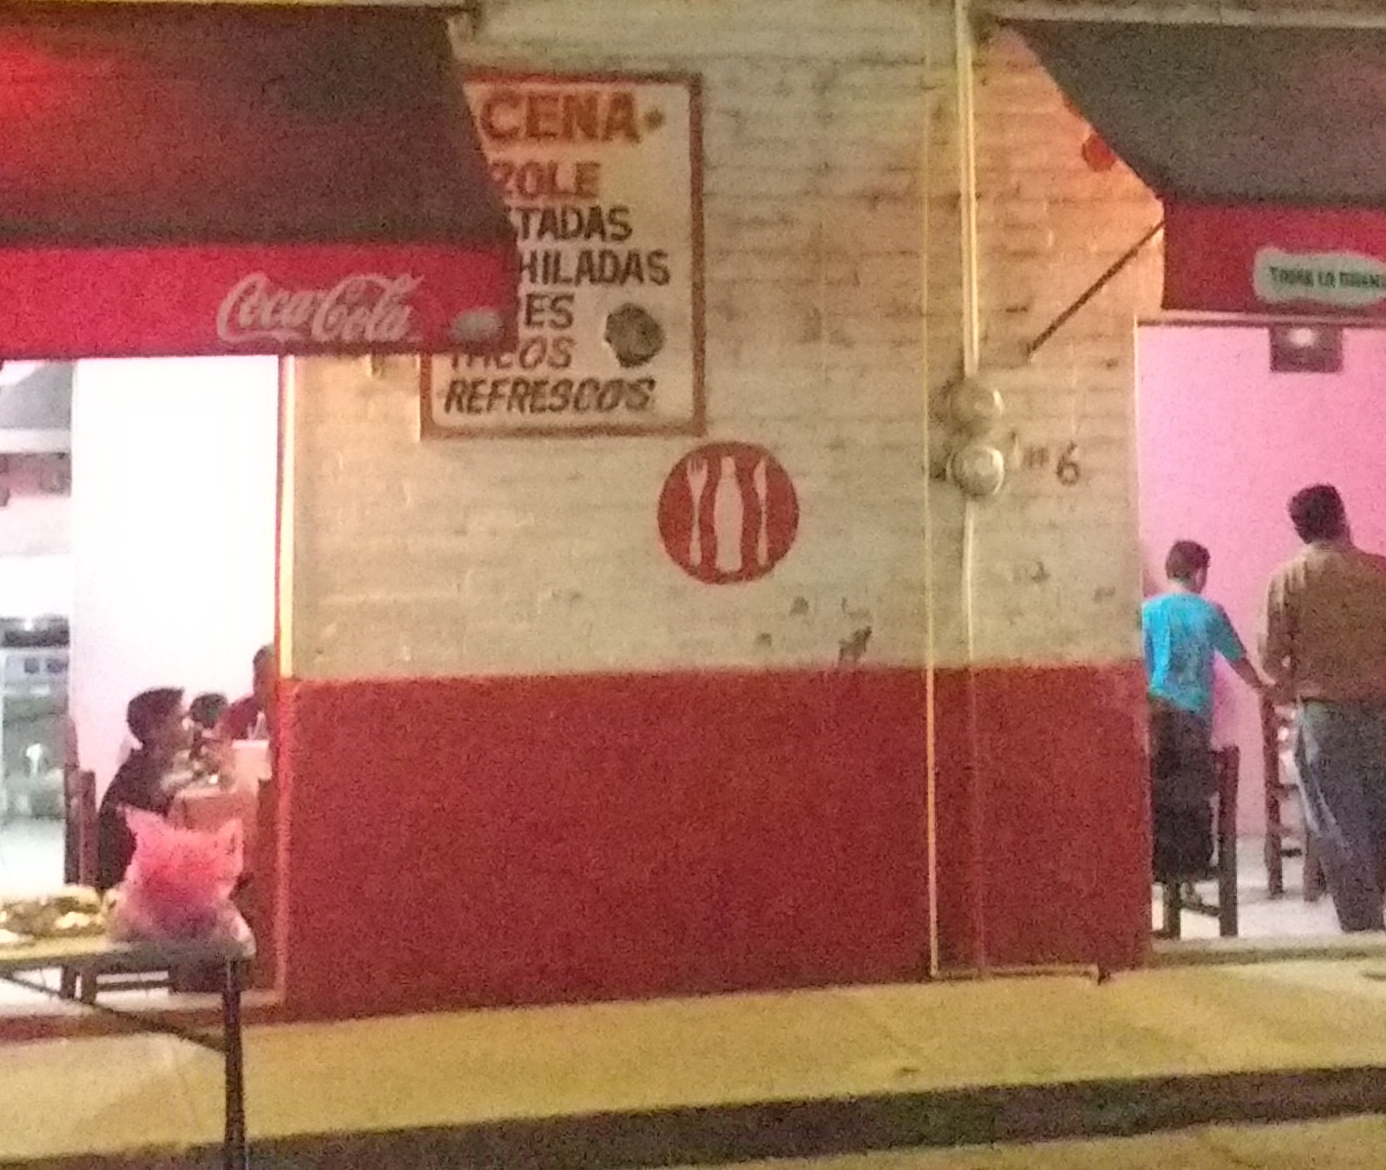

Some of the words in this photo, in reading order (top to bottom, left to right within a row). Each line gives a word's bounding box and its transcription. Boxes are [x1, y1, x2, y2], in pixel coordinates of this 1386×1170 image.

[479, 90, 641, 145] CENA
[508, 204, 634, 242] TADAS
[444, 376, 657, 415] REFRESCOS
